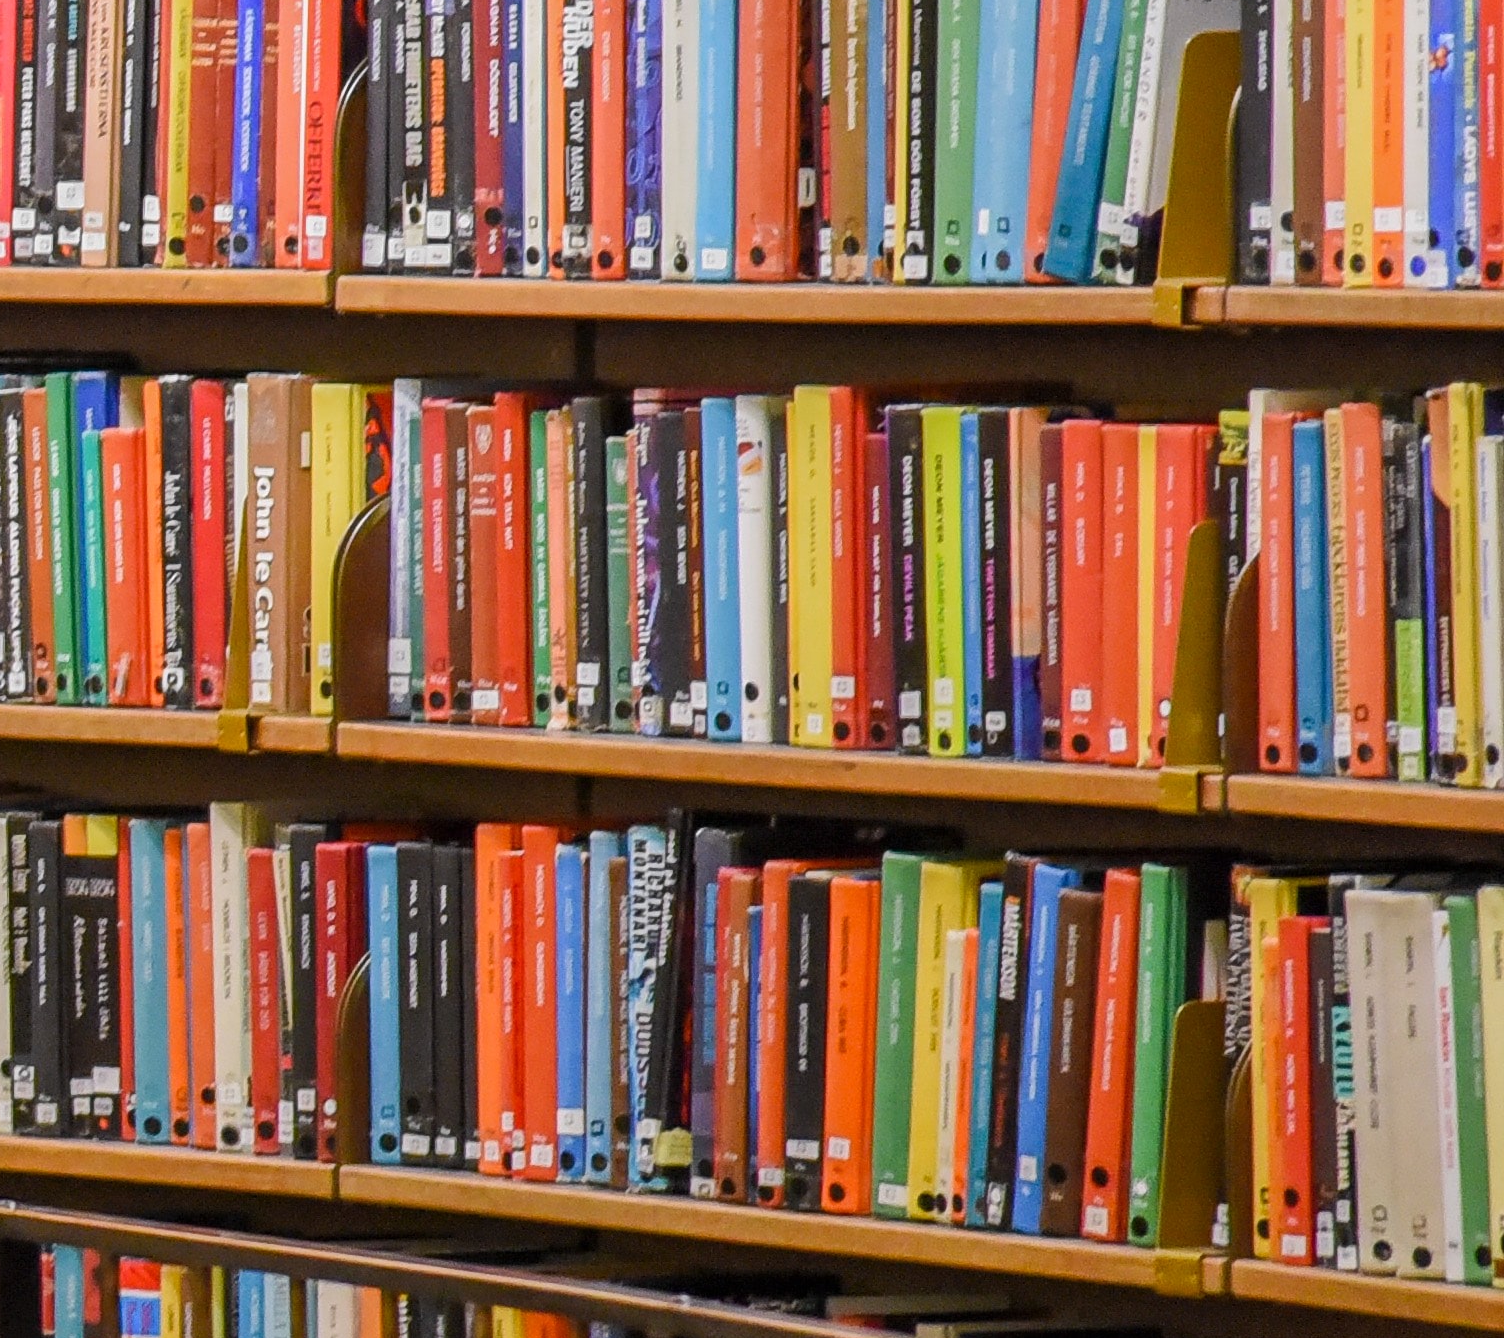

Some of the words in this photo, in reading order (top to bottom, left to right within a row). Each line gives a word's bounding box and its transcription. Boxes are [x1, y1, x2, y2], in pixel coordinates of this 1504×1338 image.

[563, 6, 578, 88] HUDEN
[569, 99, 584, 142] TONY
[568, 145, 584, 213] MANIERI
[254, 465, 275, 540] John
[982, 458, 994, 498] DEON
[900, 496, 913, 547] MEYER
[982, 499, 995, 550] MEYER
[255, 550, 275, 583] le
[254, 586, 274, 654] Carr
